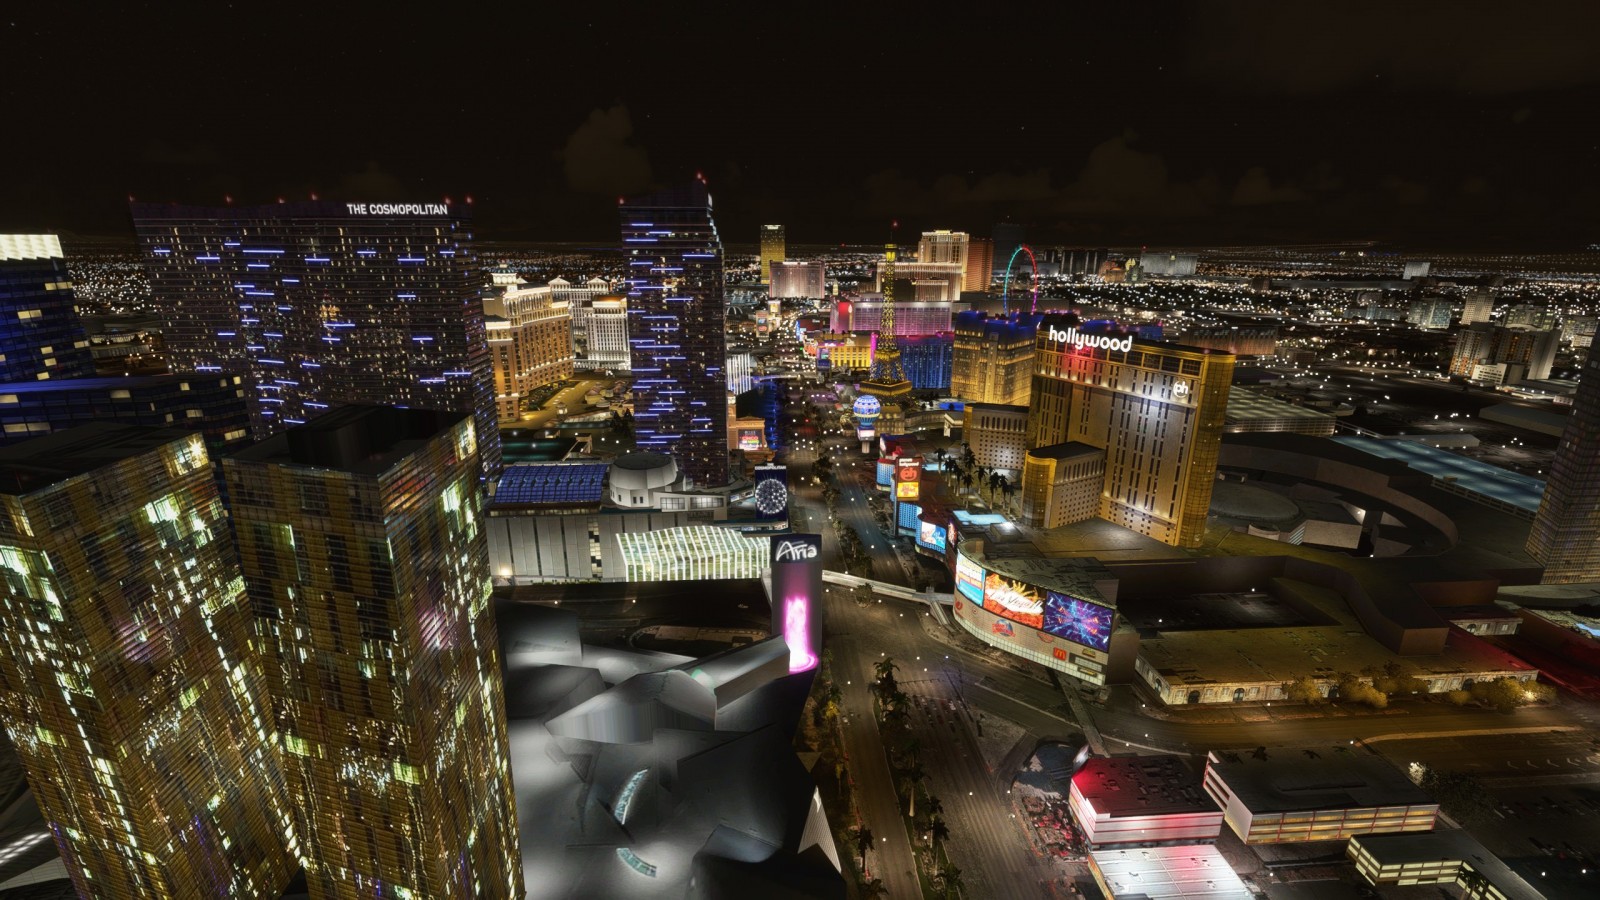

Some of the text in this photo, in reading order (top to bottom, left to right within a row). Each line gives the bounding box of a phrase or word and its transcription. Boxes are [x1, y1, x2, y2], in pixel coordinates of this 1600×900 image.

[347, 204, 448, 215] THE COSMOPOLITAN
[1049, 324, 1133, 353] hollywood
[776, 540, 818, 562] Aria
